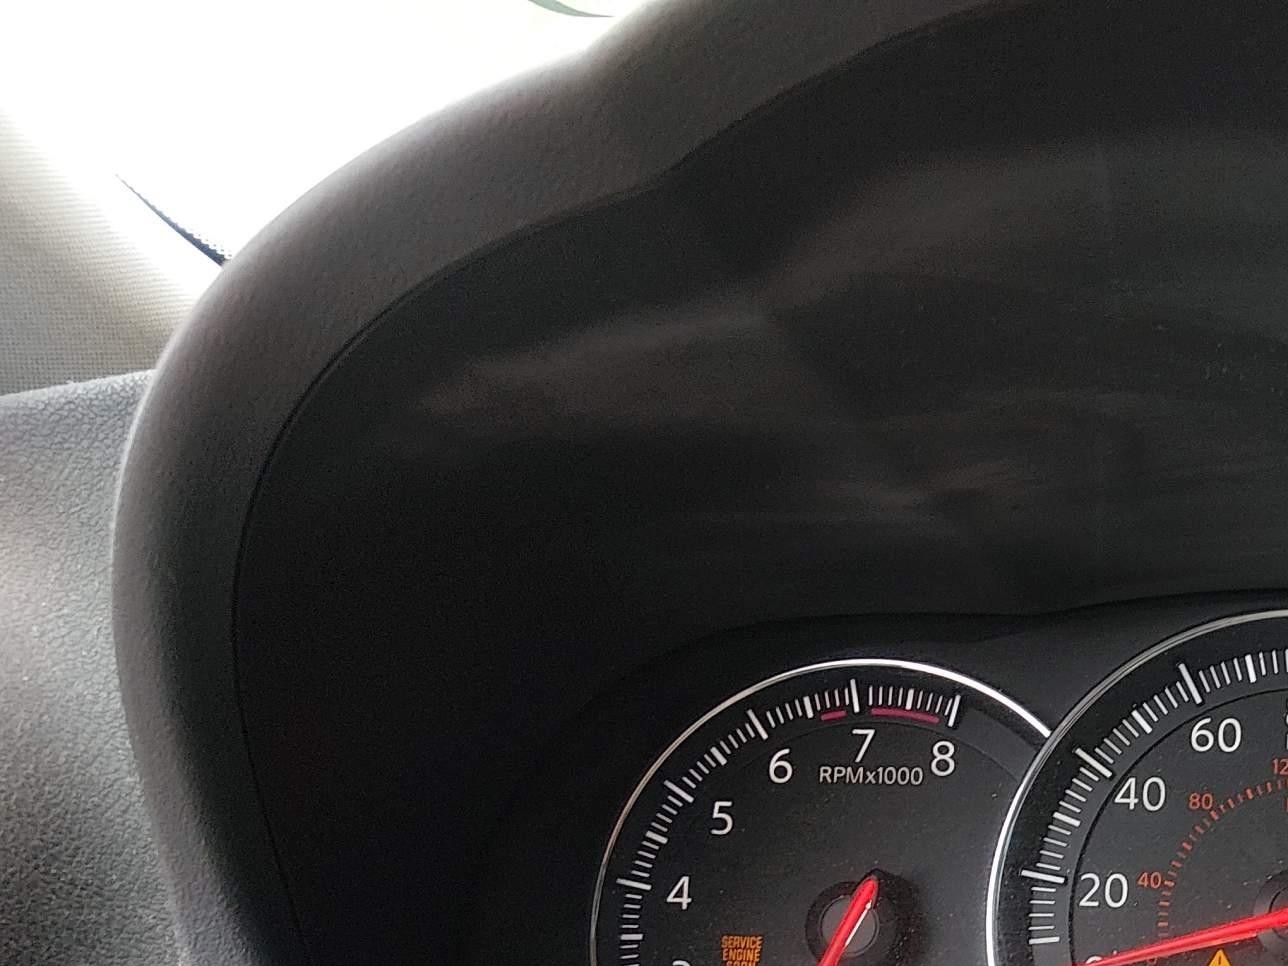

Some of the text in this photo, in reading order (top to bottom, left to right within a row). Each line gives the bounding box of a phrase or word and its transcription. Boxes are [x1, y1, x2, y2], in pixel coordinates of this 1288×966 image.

[852, 729, 875, 762] 7
[1191, 718, 1242, 752] 60
[768, 749, 793, 783] 6
[930, 741, 956, 776] 8
[818, 766, 923, 786] RPMx1000
[1115, 778, 1166, 811] 40
[1189, 793, 1214, 809] 80
[710, 802, 734, 836] 5
[666, 876, 691, 910] 4
[1079, 874, 1128, 909] 20
[1137, 871, 1162, 889] 40
[721, 935, 763, 949] SERVICE
[722, 948, 760, 961] ENGINE
